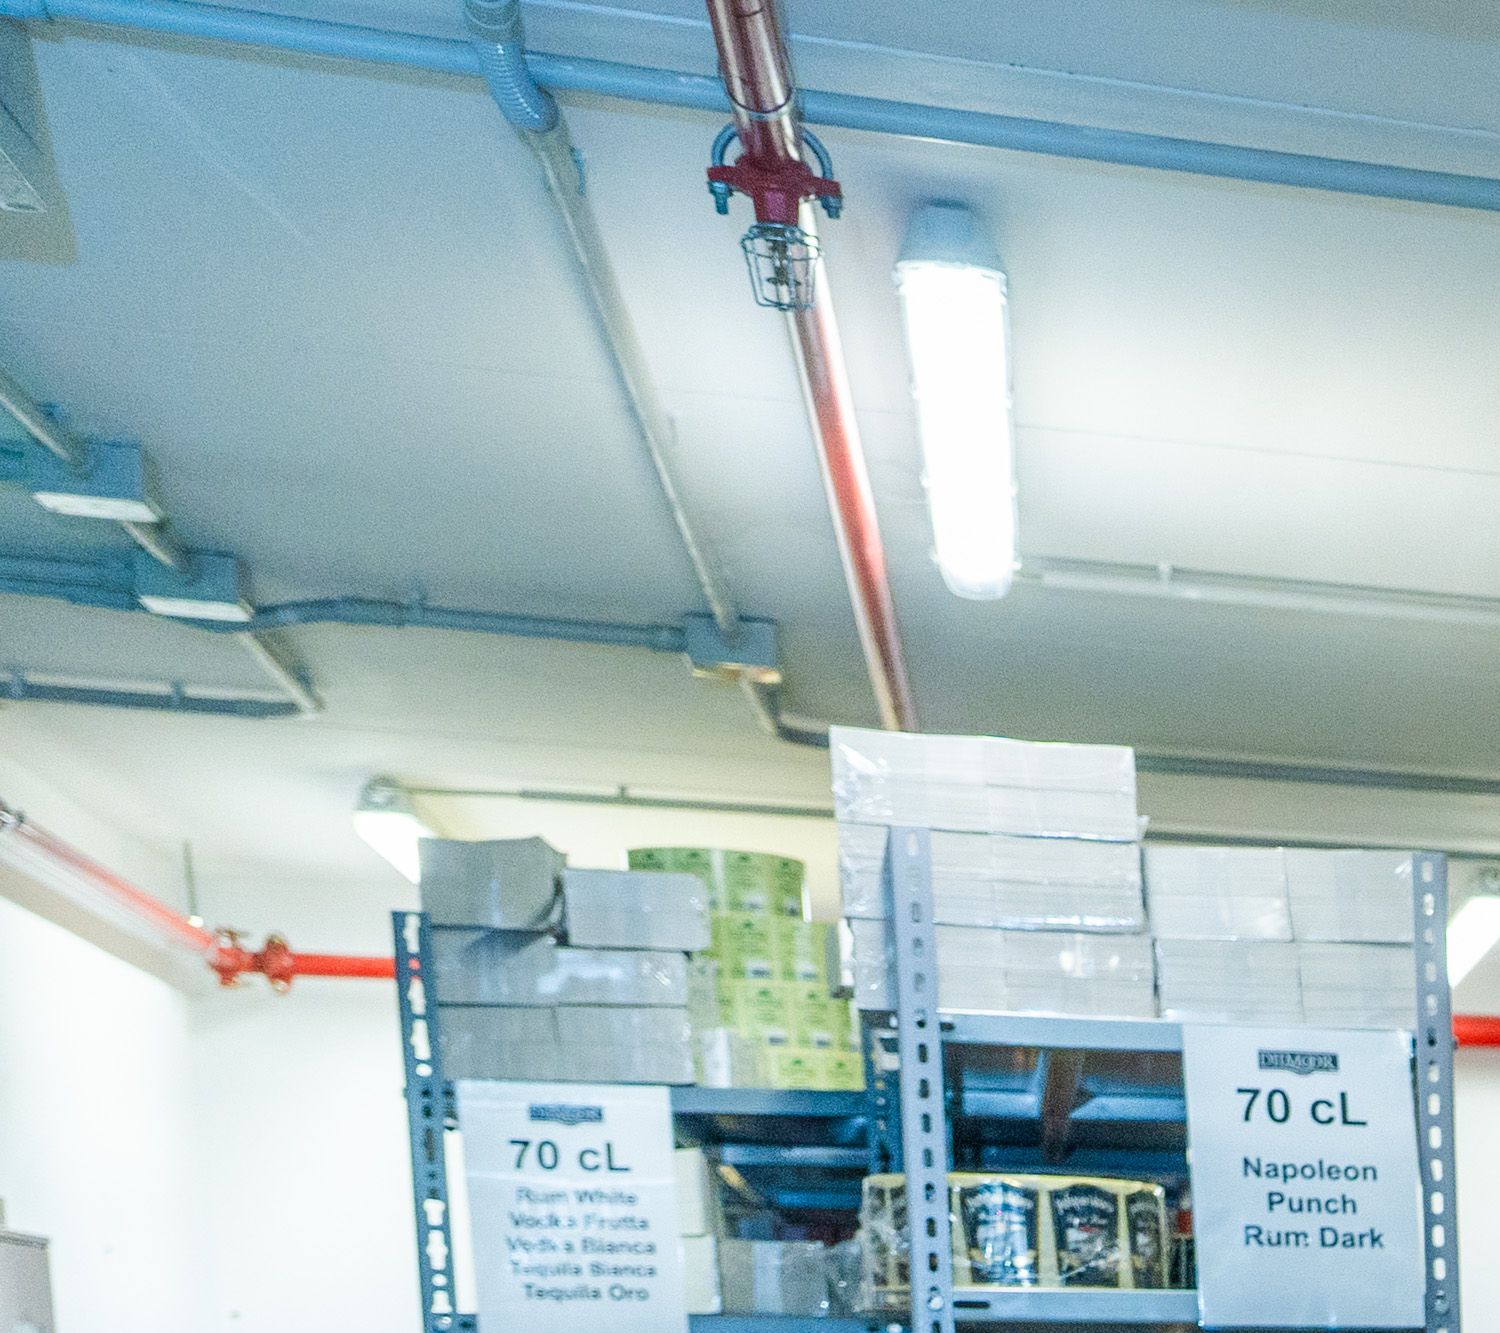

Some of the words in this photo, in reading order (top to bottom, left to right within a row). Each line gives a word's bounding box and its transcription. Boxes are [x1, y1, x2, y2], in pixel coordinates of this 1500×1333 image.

[1237, 1087, 1290, 1124] 70
[1311, 1091, 1368, 1126] cL
[509, 1140, 559, 1171] 70
[579, 1142, 631, 1172] cL
[1243, 1156, 1378, 1184] Napoleon
[516, 1187, 568, 1204] Rum
[573, 1188, 638, 1205] White
[1266, 1191, 1358, 1214] Punch
[508, 1212, 576, 1229] Vodka
[584, 1213, 649, 1230] Frutta
[507, 1235, 574, 1253] Vodka
[581, 1238, 657, 1255] Bianca
[1243, 1225, 1309, 1248] Rum
[1320, 1227, 1385, 1249] Dark
[511, 1259, 582, 1278] Tequila
[589, 1261, 658, 1278] Bianca
[523, 1283, 602, 1303] Tequila
[608, 1284, 650, 1302] Oro
